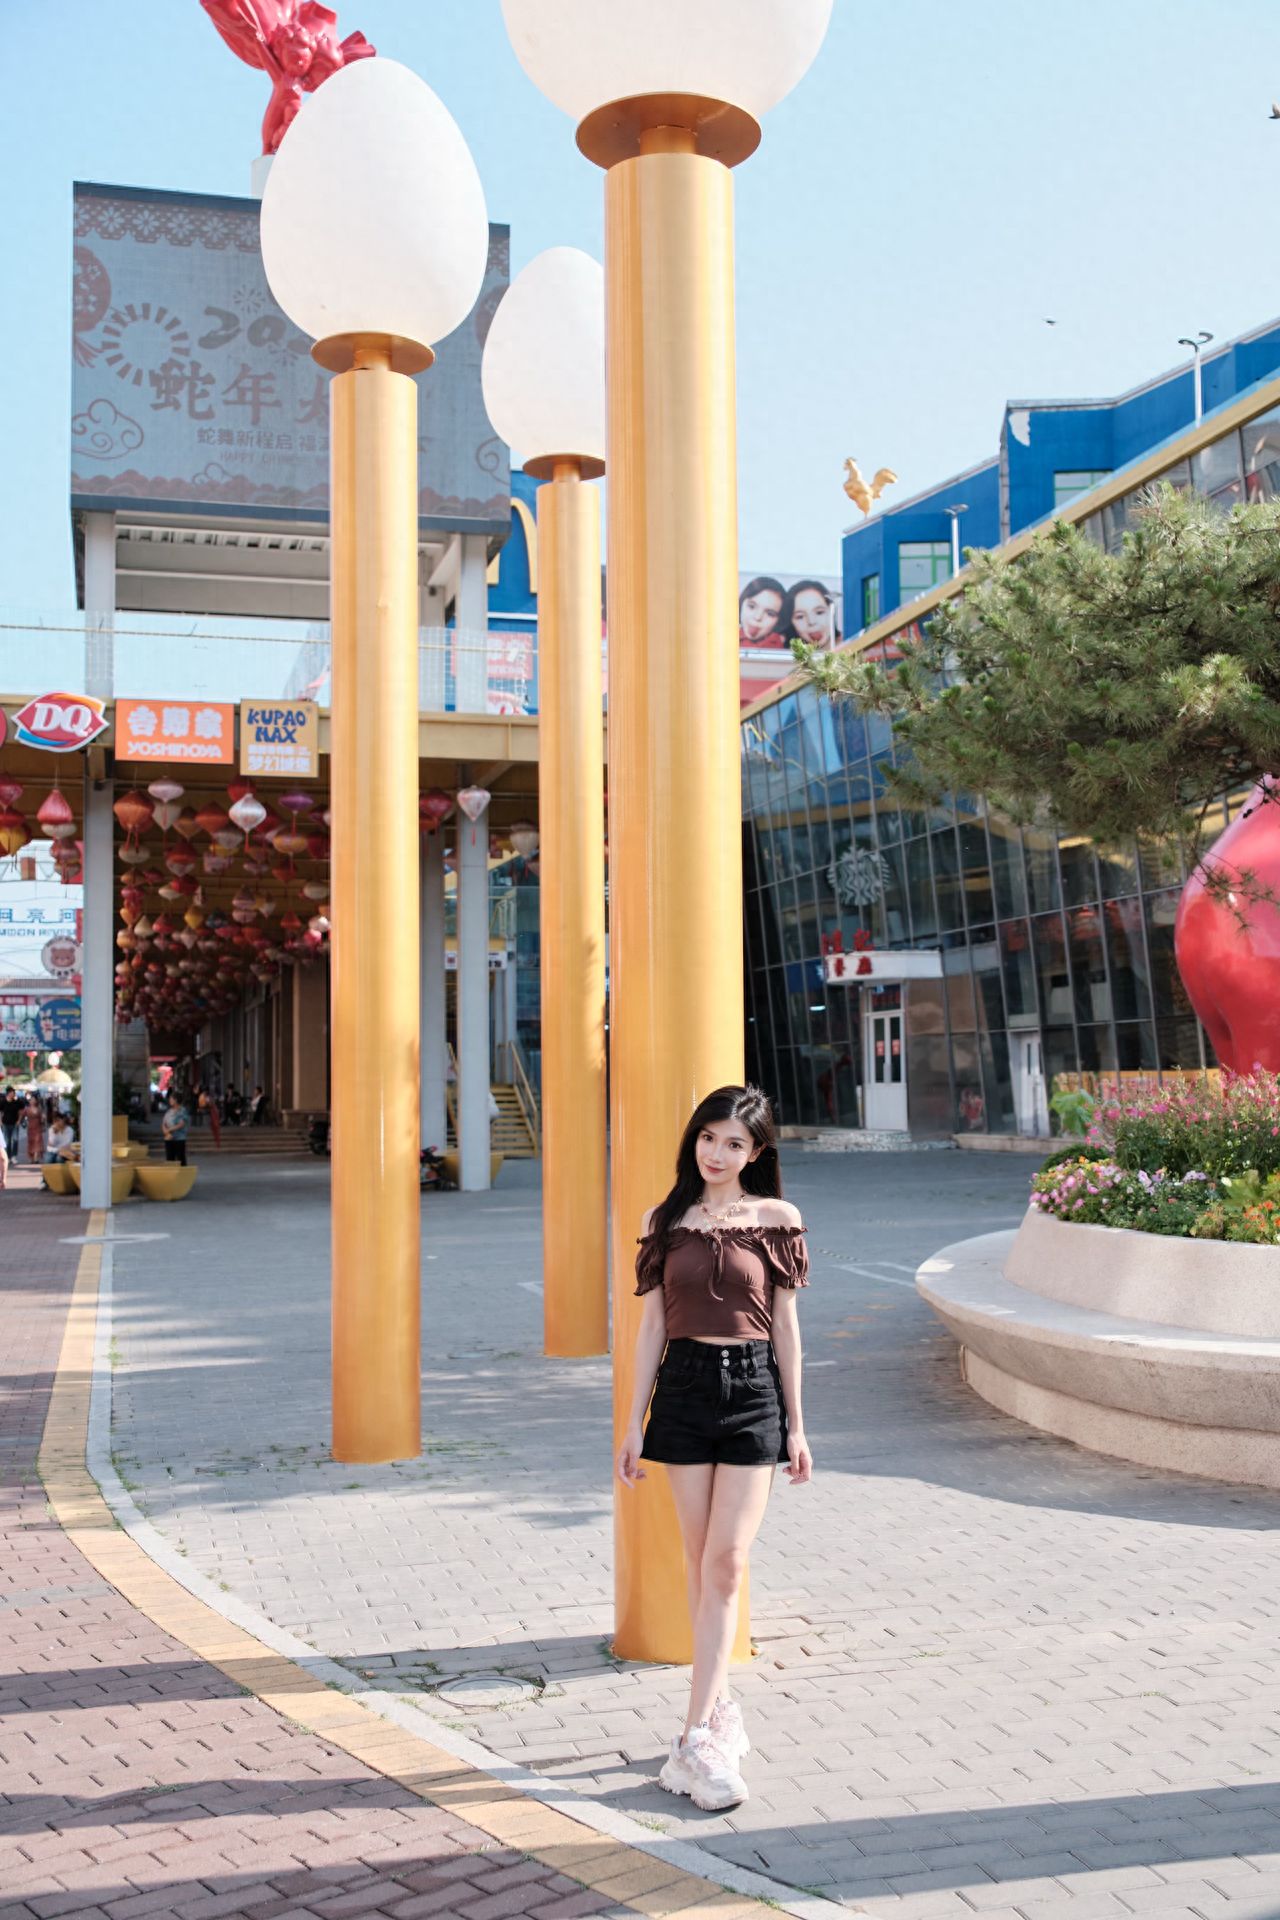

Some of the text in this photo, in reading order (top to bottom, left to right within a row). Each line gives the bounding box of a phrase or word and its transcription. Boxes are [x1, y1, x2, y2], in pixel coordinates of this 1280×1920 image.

[31, 702, 92, 737] DQ
[247, 708, 306, 727] KUPAO
[256, 726, 297, 743] MAX
